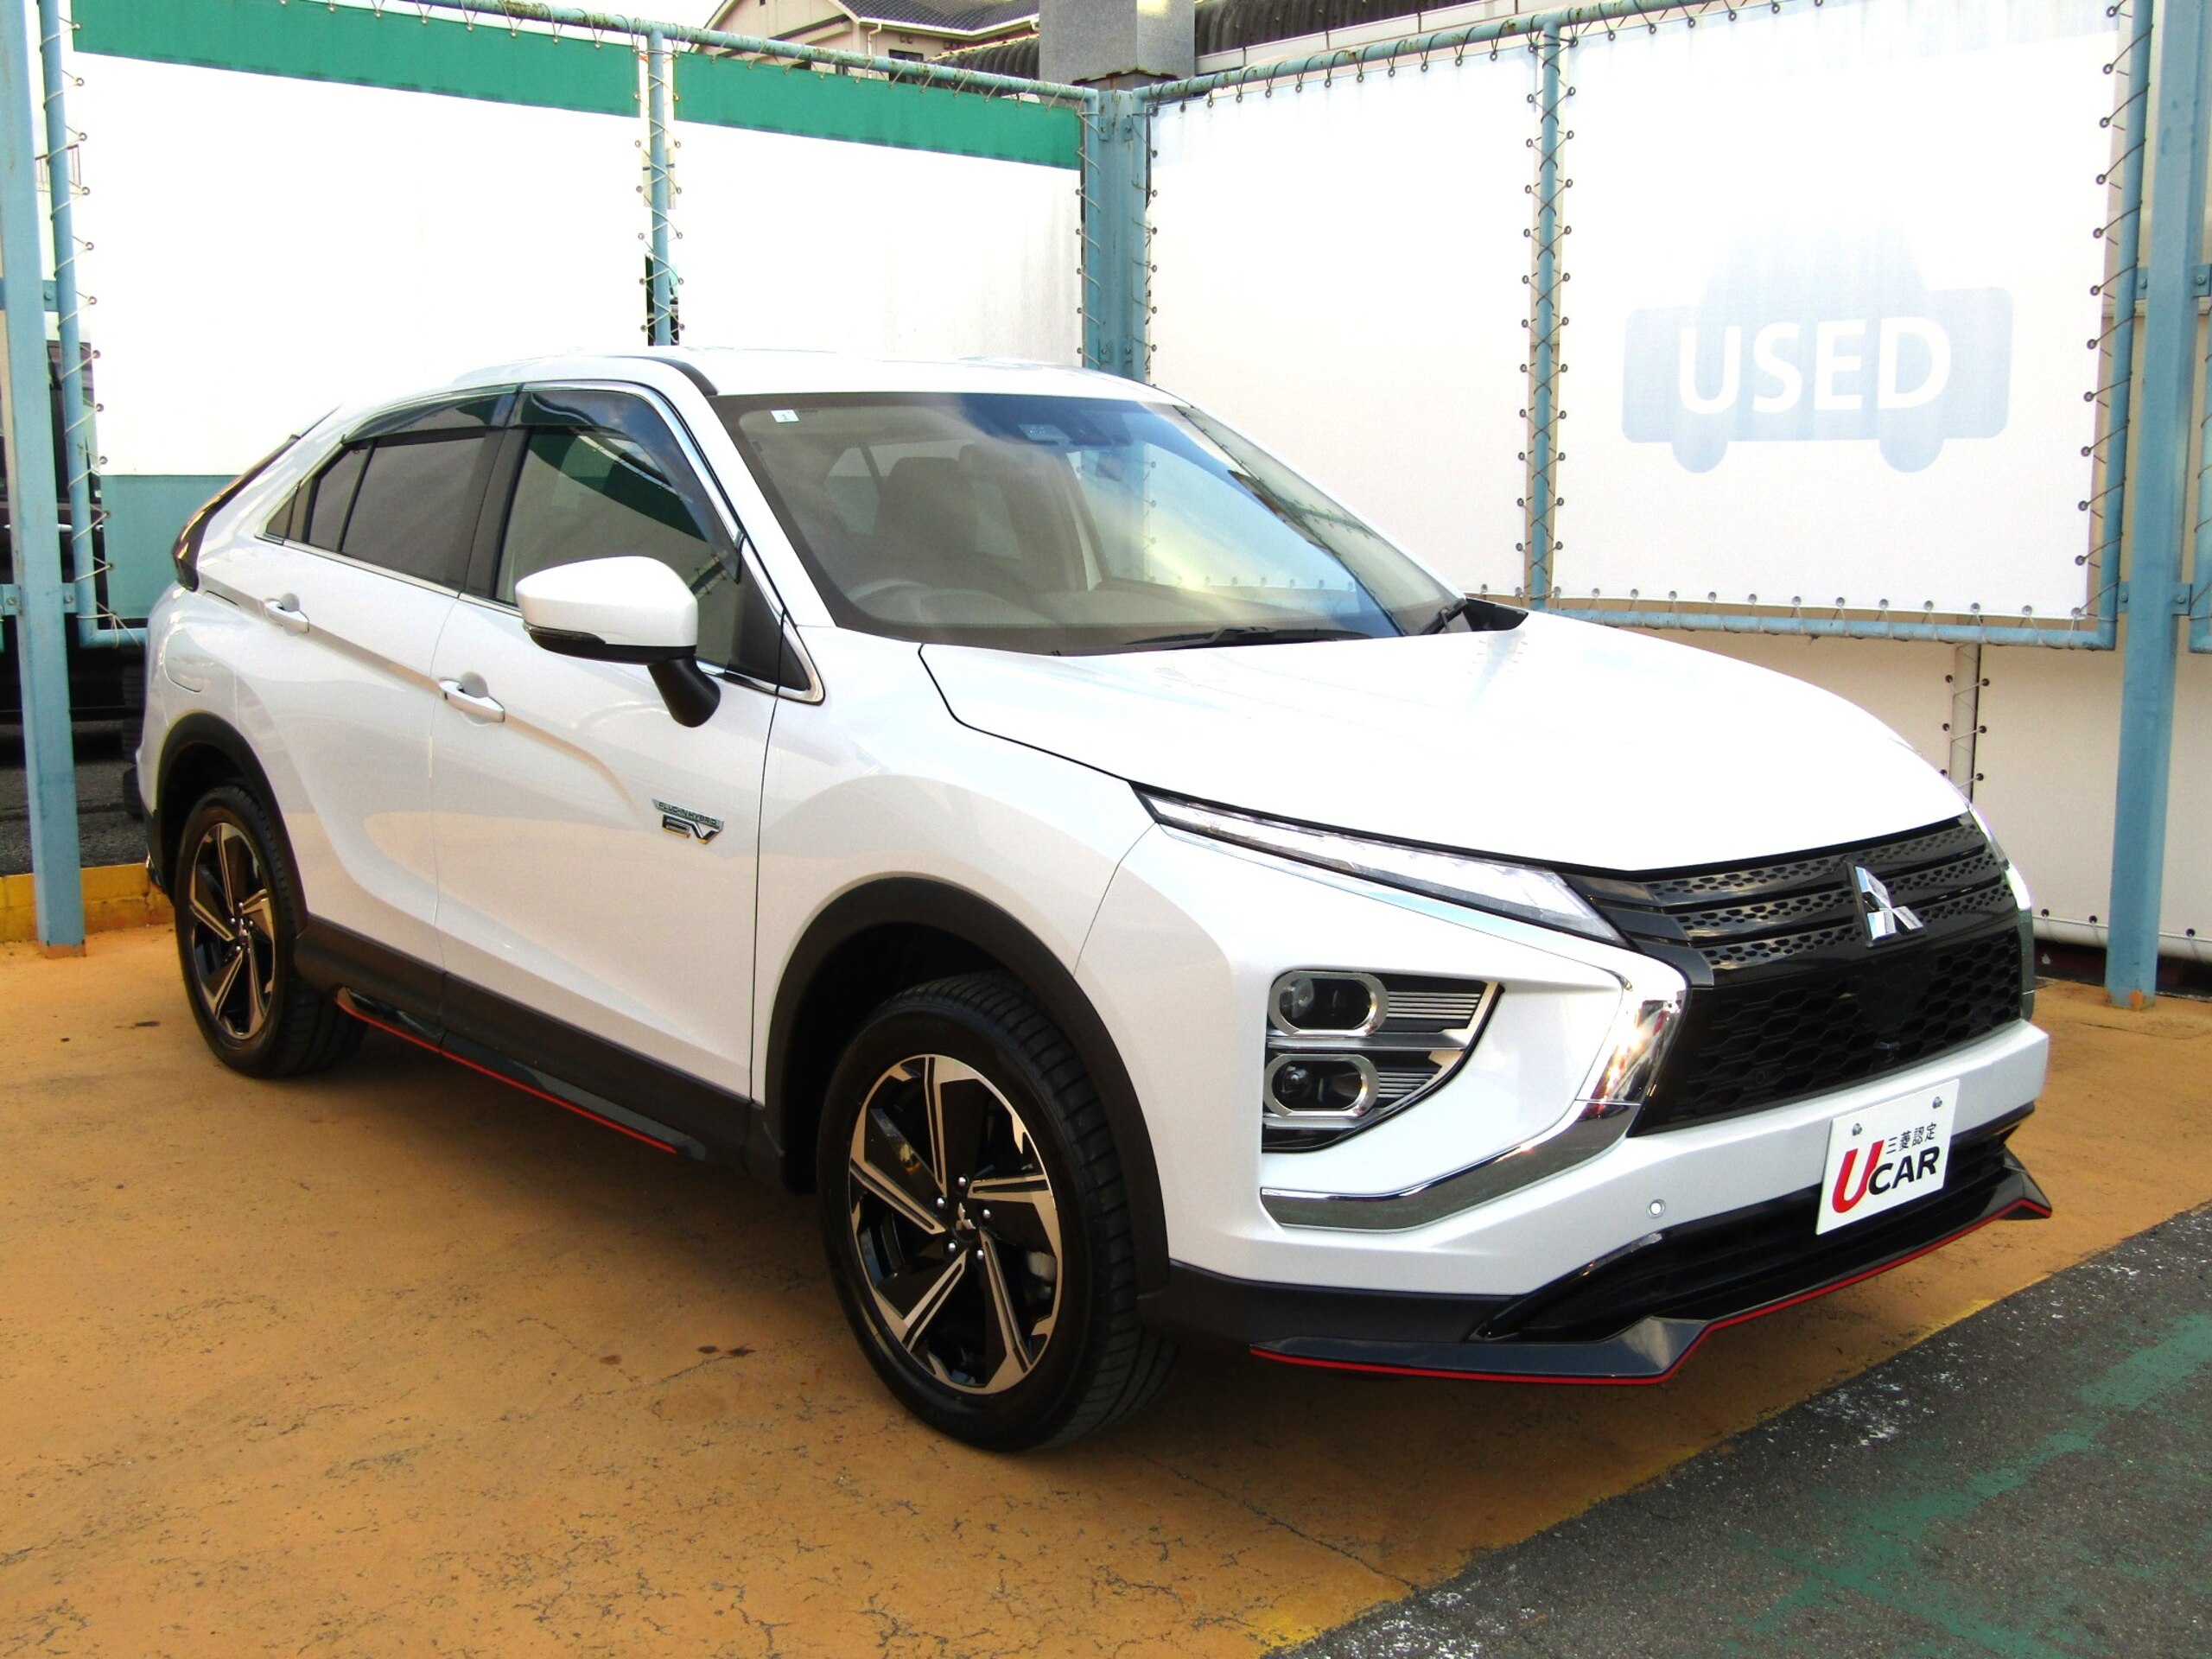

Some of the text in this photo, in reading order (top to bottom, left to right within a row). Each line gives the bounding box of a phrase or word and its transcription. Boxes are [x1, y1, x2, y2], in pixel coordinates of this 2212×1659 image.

[1678, 316, 1952, 415] USED
[662, 812, 720, 843] EV
[688, 810, 717, 826] HYBRID
[1885, 1122, 1937, 1154] 三菱認定
